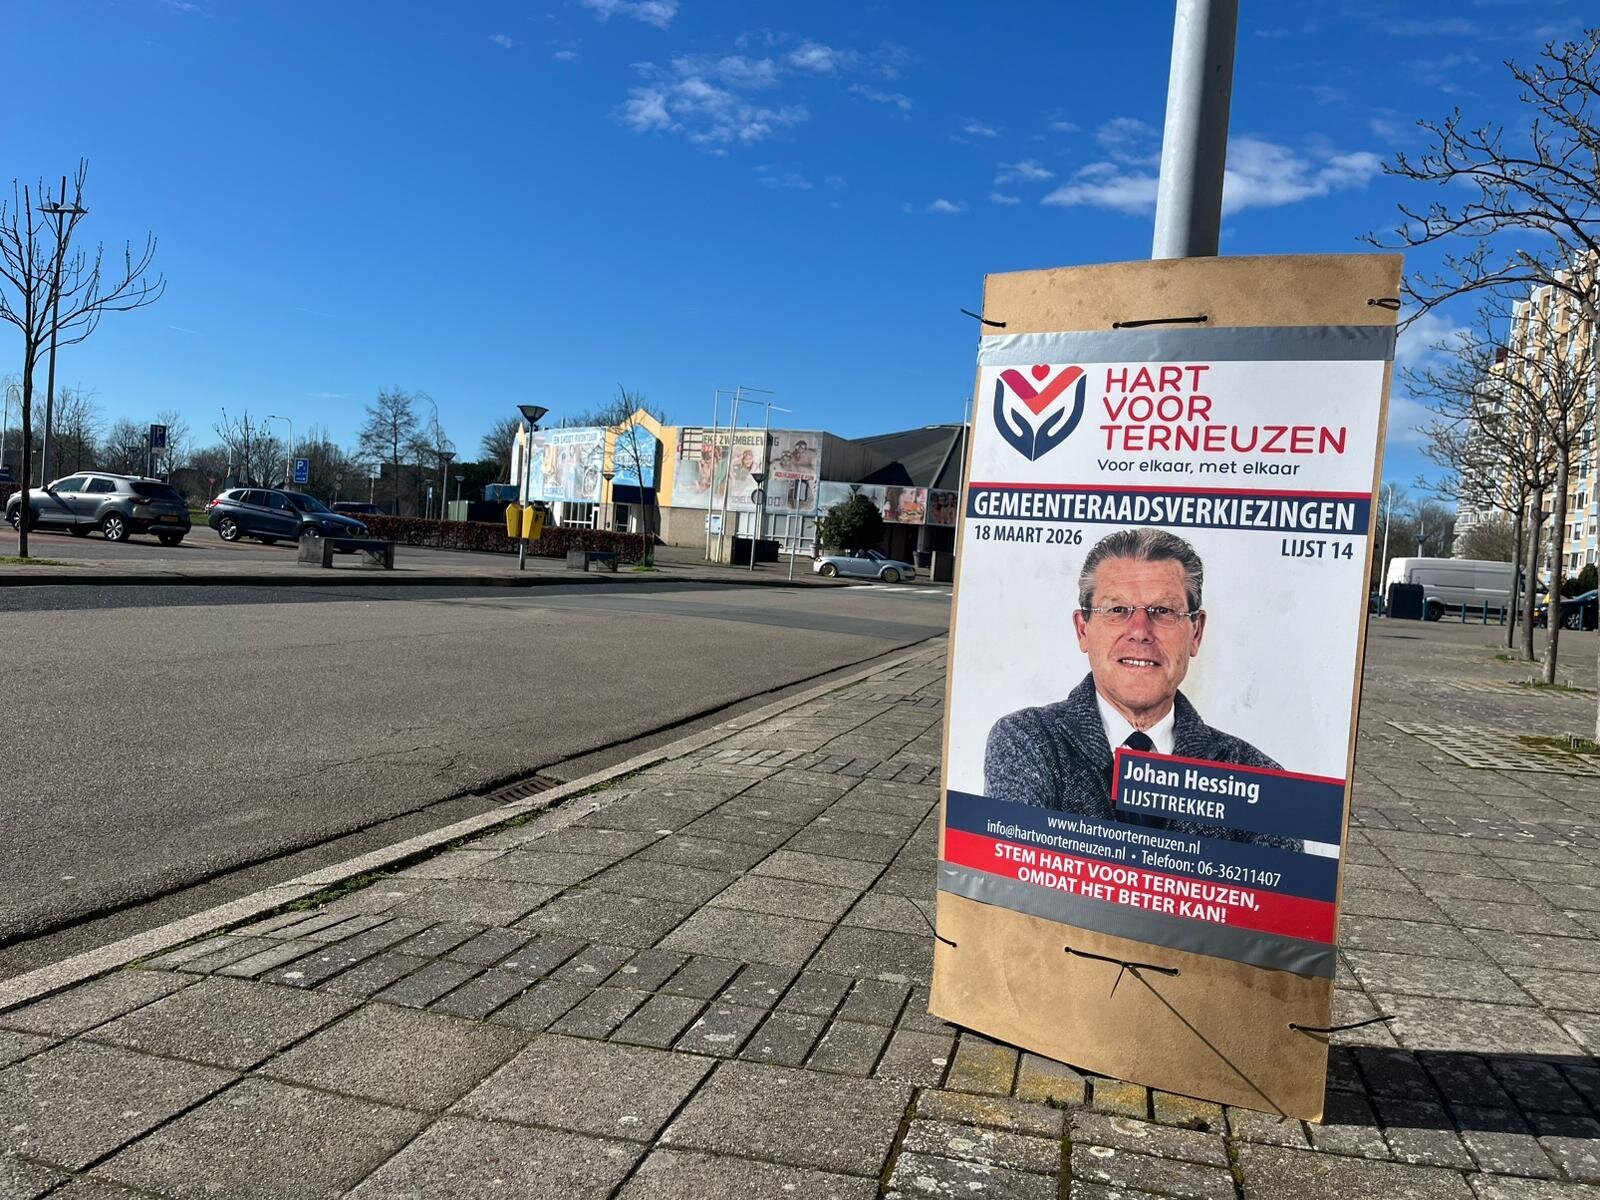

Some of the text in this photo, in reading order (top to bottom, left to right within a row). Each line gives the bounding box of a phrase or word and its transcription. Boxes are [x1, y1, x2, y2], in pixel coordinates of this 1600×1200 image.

[1105, 365, 1210, 393] HART
[1102, 395, 1213, 422] VOOR
[1099, 424, 1347, 454] TERNEUZEN
[296, 460, 304, 470] P
[1097, 458, 1300, 476] Voor elkaar, met elkaar
[974, 491, 1355, 531] GEMEENTERAADSVERKIEZINGEN
[974, 524, 1083, 545] 18 MAART 2026
[1281, 538, 1354, 560] LIJST 14
[1124, 760, 1260, 804] Johan Hessing
[1123, 788, 1226, 820] LIJSTTREKKER
[1047, 816, 1201, 855] www.hartvoorterneuzen.nl
[987, 819, 1282, 887] info@hartvoorterneuzen.nl Telefoon: 06-36211407
[994, 843, 1260, 912] STEM HART VOOR TERNEUZEN,
[1017, 867, 1227, 924] OMDAT HET BETER KAN!
